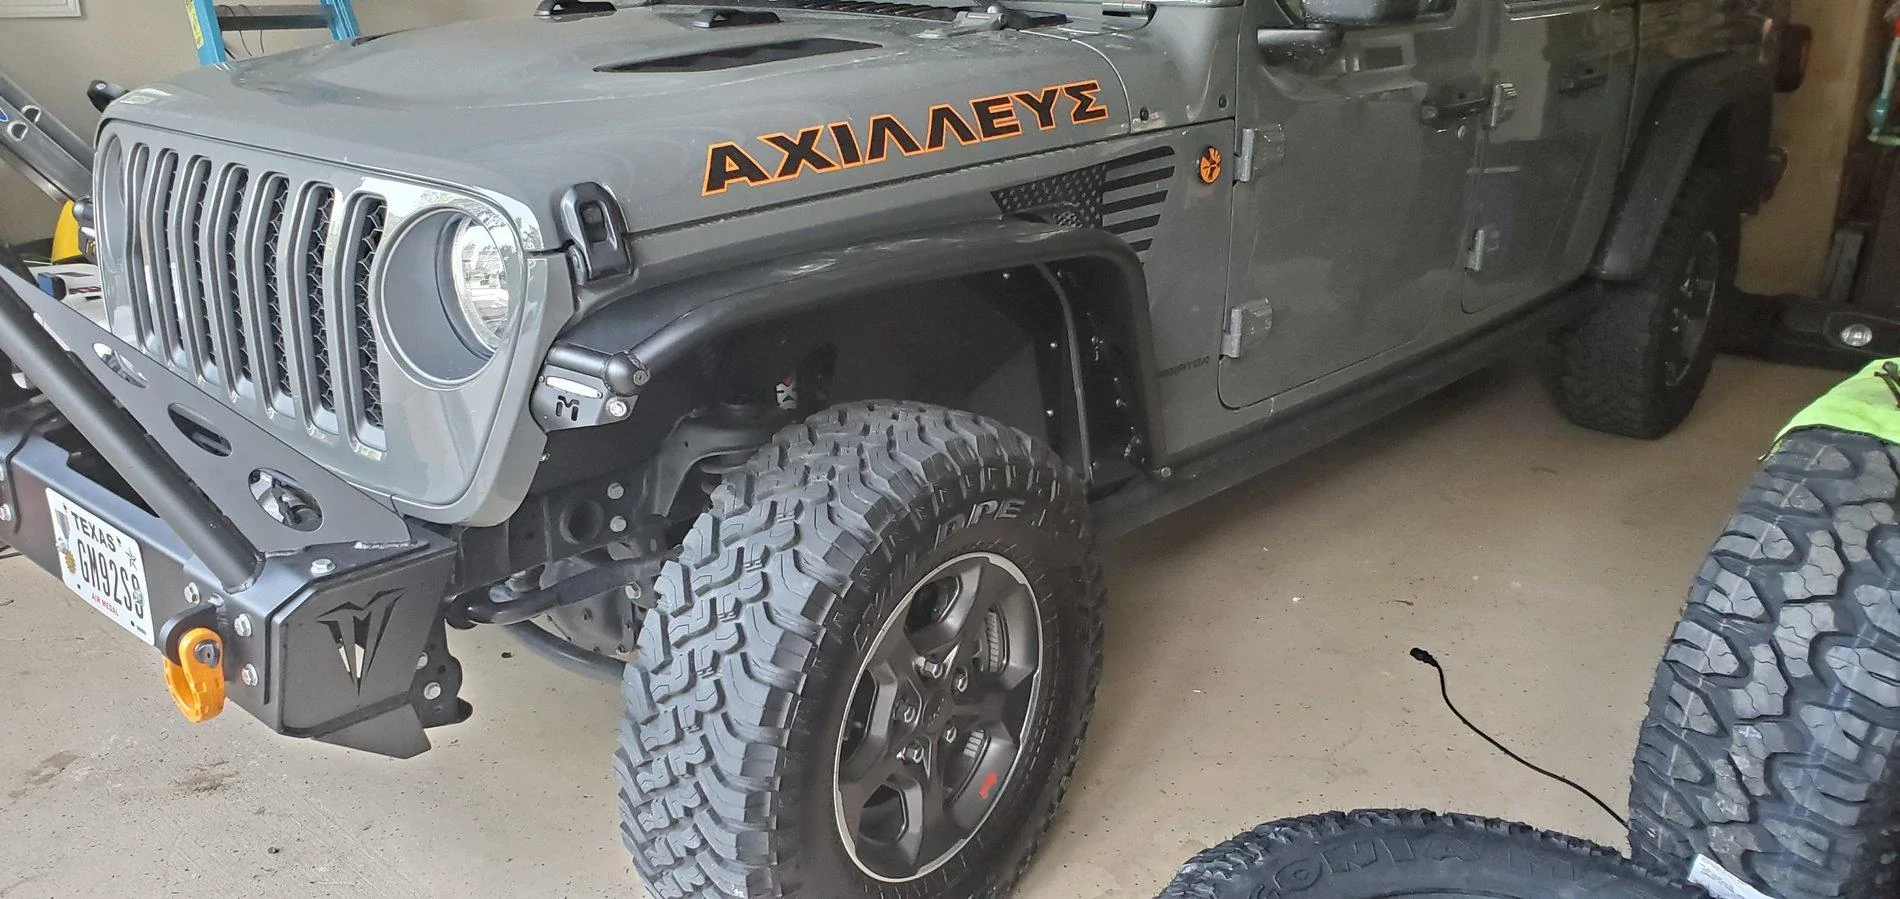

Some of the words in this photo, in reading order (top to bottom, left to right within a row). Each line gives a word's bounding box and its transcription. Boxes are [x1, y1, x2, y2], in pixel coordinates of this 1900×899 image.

[70, 510, 117, 553] TEXAS
[91, 591, 101, 606] AIR
[101, 598, 120, 617] MEDAL
